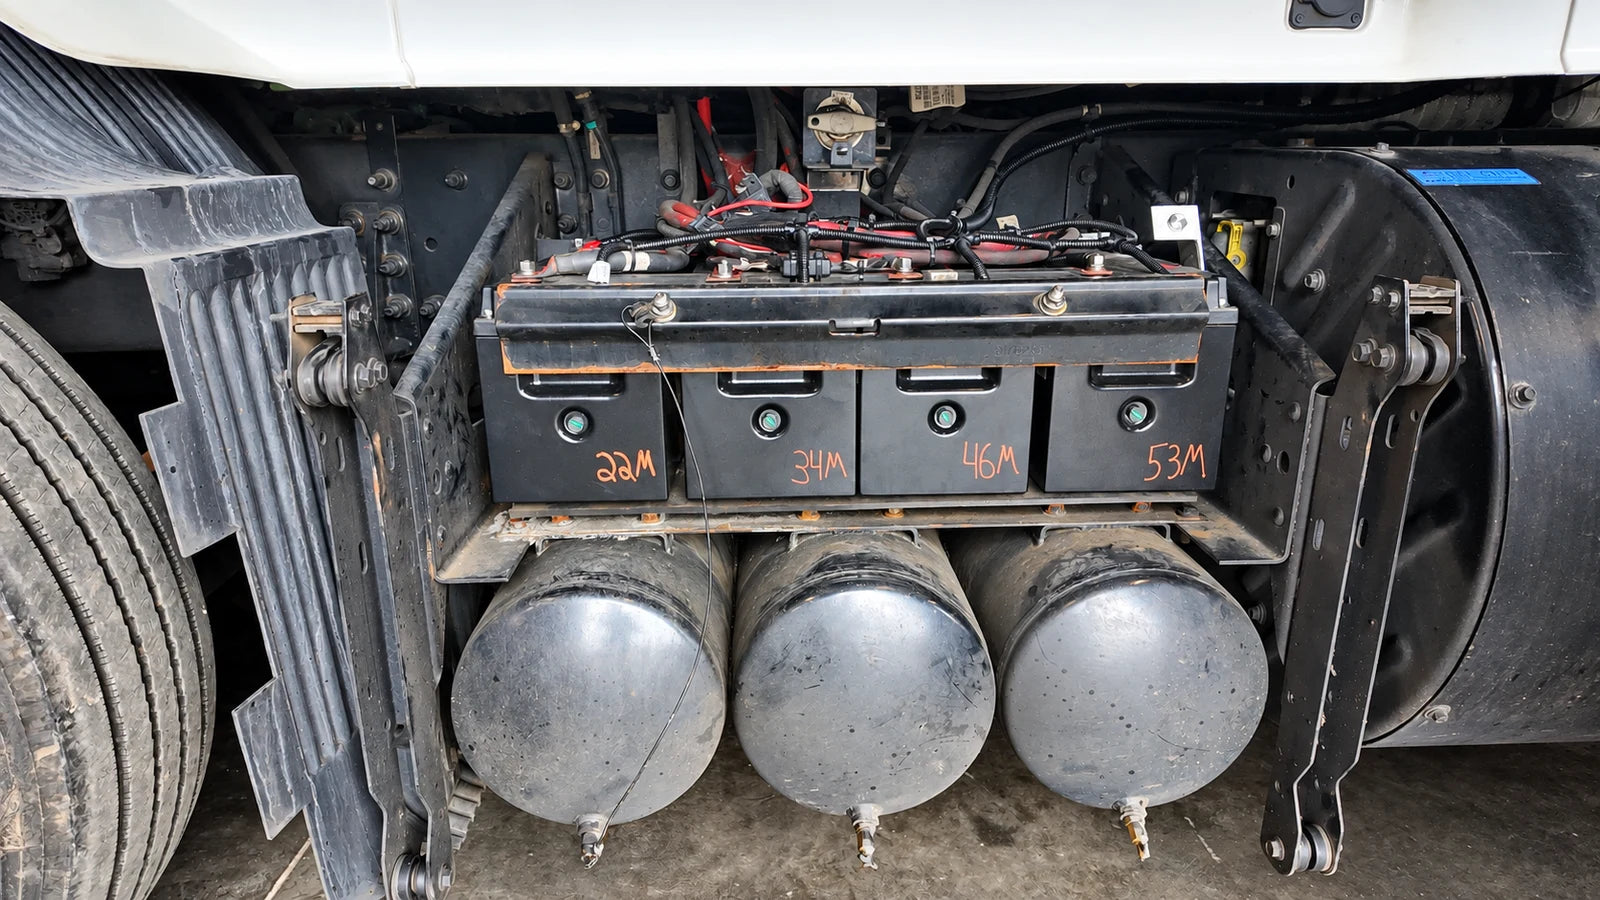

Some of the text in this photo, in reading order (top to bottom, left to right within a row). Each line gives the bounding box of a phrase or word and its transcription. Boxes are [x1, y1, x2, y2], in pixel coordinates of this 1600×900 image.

[596, 449, 656, 482] 22M
[792, 449, 847, 484] 34M
[963, 442, 1019, 479] 46M
[1144, 443, 1207, 482] 53M
